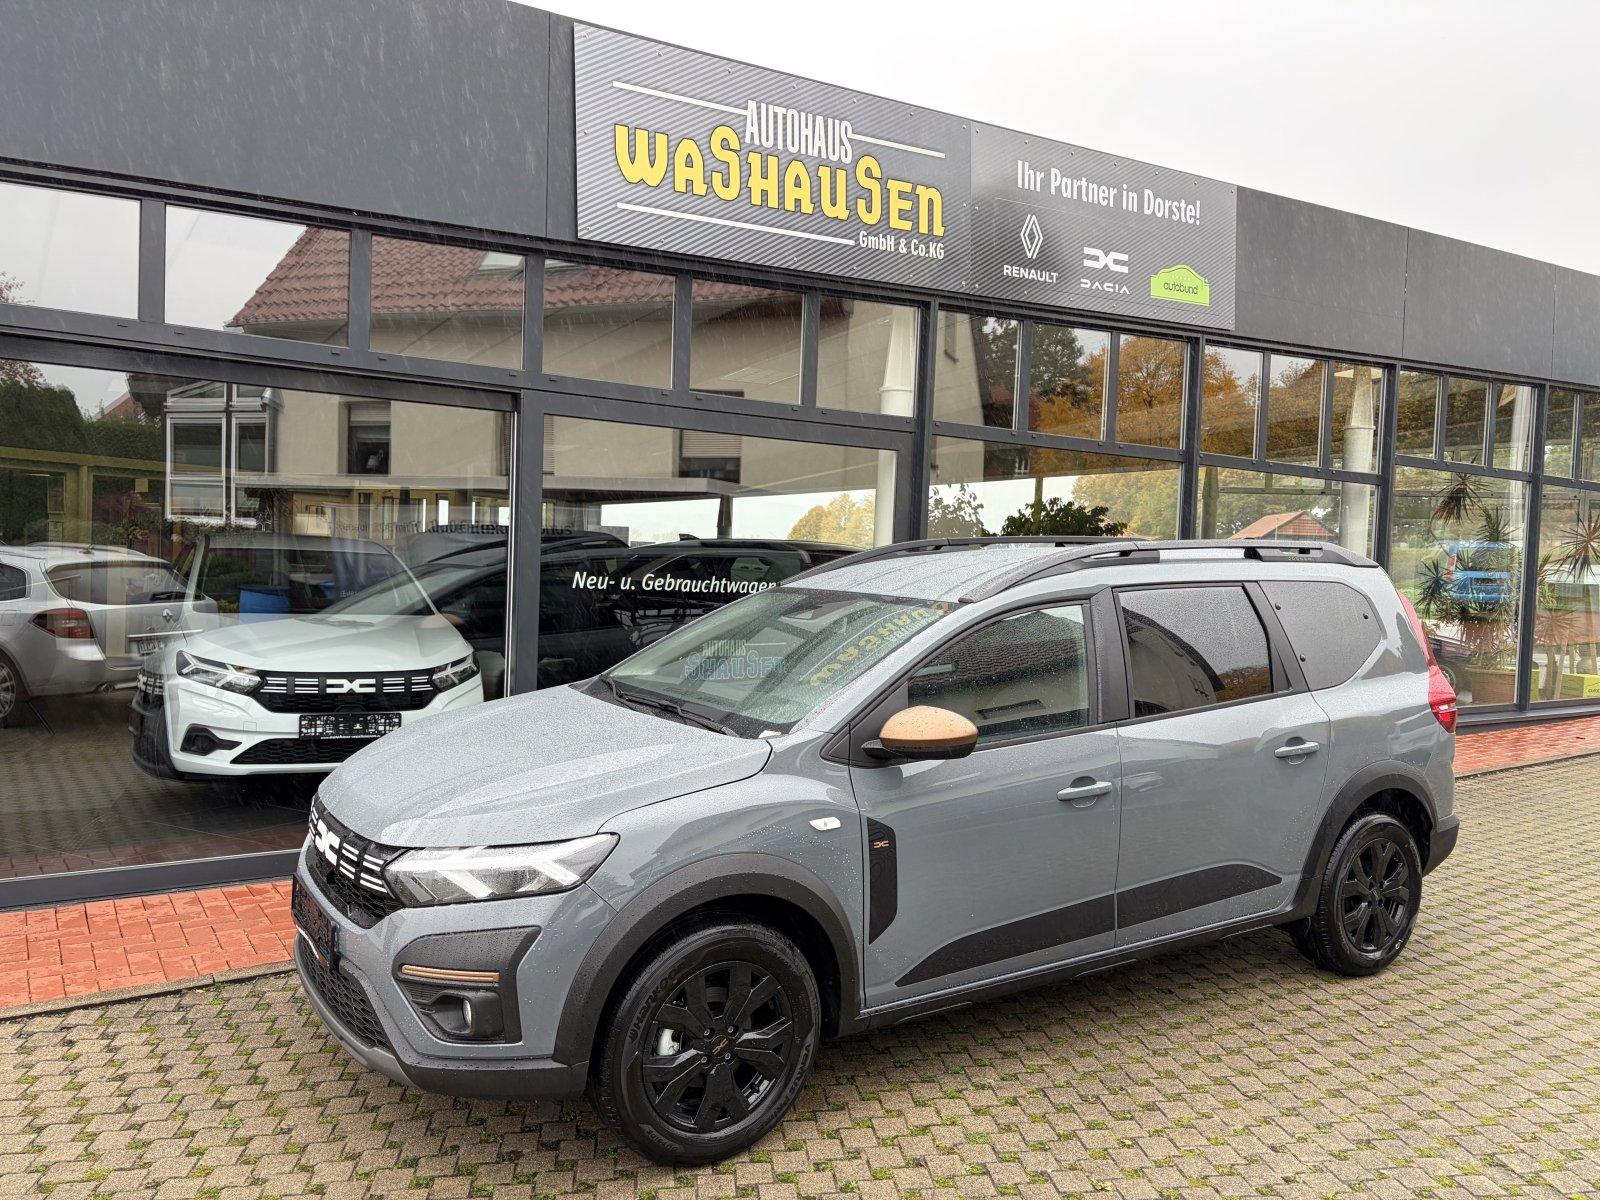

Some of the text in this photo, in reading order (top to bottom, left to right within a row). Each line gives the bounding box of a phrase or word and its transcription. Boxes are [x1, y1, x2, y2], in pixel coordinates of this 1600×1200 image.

[745, 100, 853, 164] AUTOHAUS
[1017, 160, 1201, 226] Ihr Partner in Dorste!
[859, 230, 945, 260] GmbH & Co.KG
[1003, 264, 1058, 283] RENAULT
[1080, 278, 1131, 295] DACIA
[572, 571, 777, 595] Neu- u. Gebrauchtwagen
[702, 639, 746, 657] AUTOHAUS
